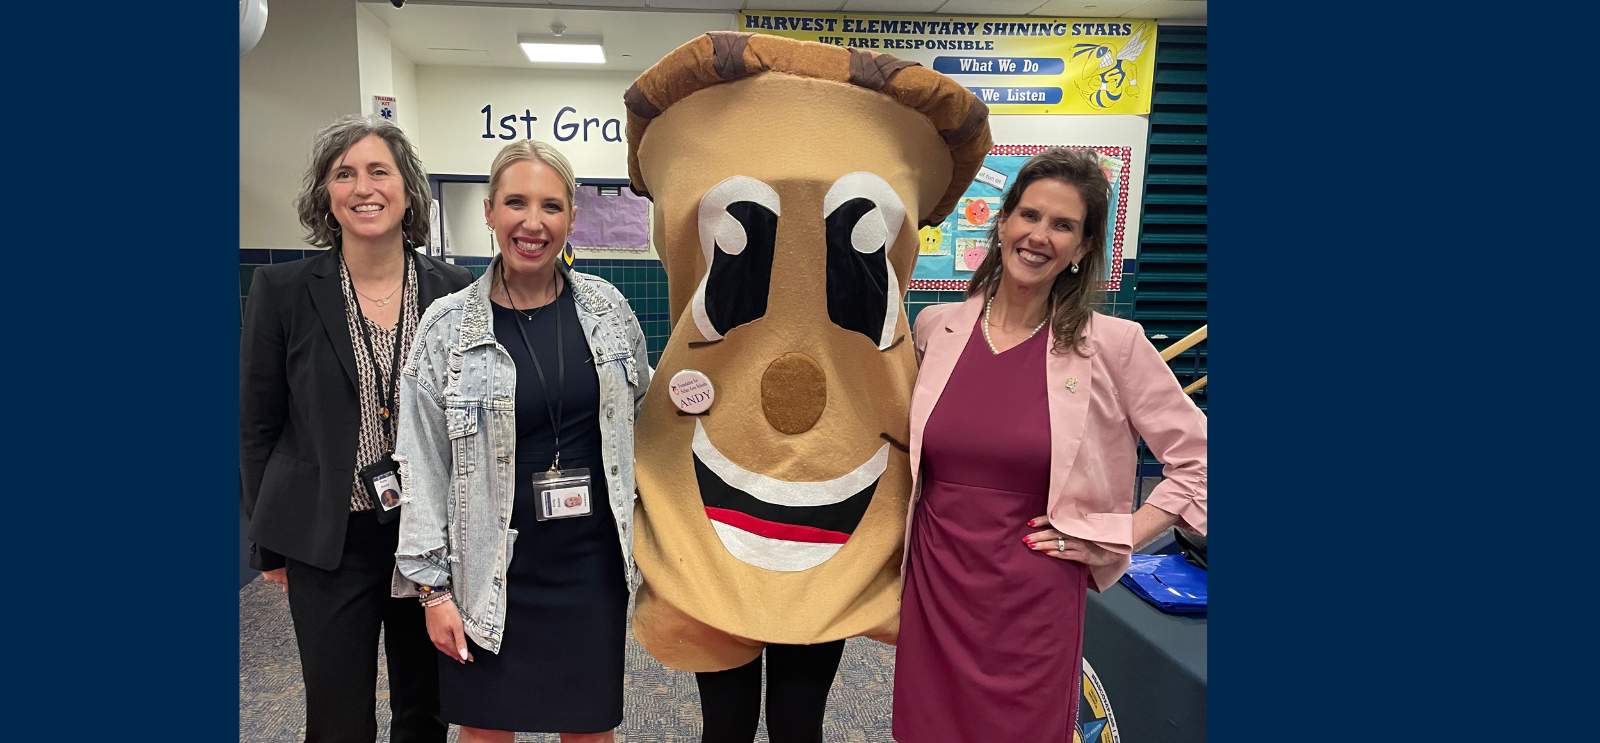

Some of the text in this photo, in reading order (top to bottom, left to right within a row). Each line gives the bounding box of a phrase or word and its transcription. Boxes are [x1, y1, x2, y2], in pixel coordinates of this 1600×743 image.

[745, 15, 1132, 37] HARVEST ELEMENTARY SHINING STARS
[819, 37, 994, 50] WE ARE RESPONSIBLE
[959, 58, 1040, 73] What We Do
[373, 95, 397, 103] TRAUMA
[980, 88, 1001, 102] We
[1006, 89, 1046, 102] Listen
[480, 104, 628, 143] 1st Gra
[985, 173, 994, 181] fun
[677, 380, 693, 388] Foundation
[680, 390, 710, 408] ANDY
